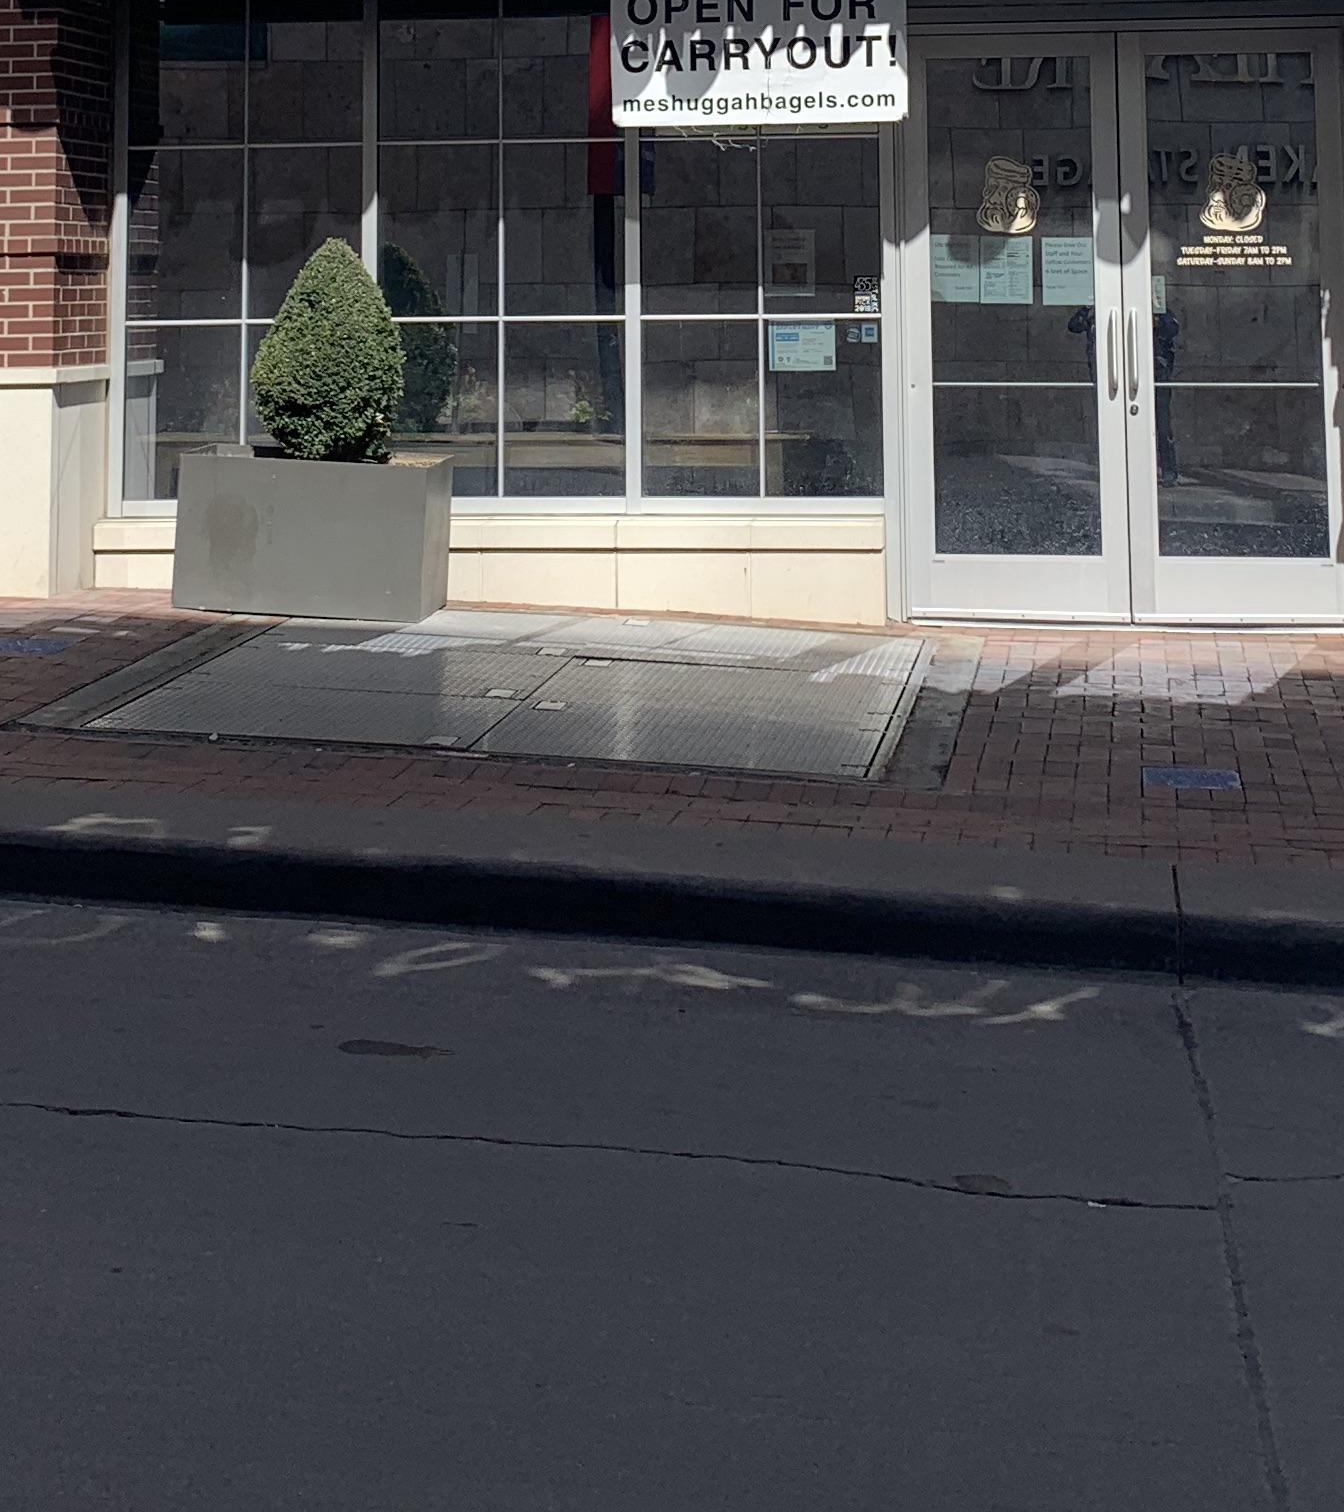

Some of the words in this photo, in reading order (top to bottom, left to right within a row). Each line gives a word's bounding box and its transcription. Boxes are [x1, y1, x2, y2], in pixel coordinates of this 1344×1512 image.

[620, 35, 898, 73] CARRYOUT!
[623, 91, 896, 115] meshuggahbagels.com
[1260, 246, 1270, 254] TO
[1265, 257, 1275, 265] TO
